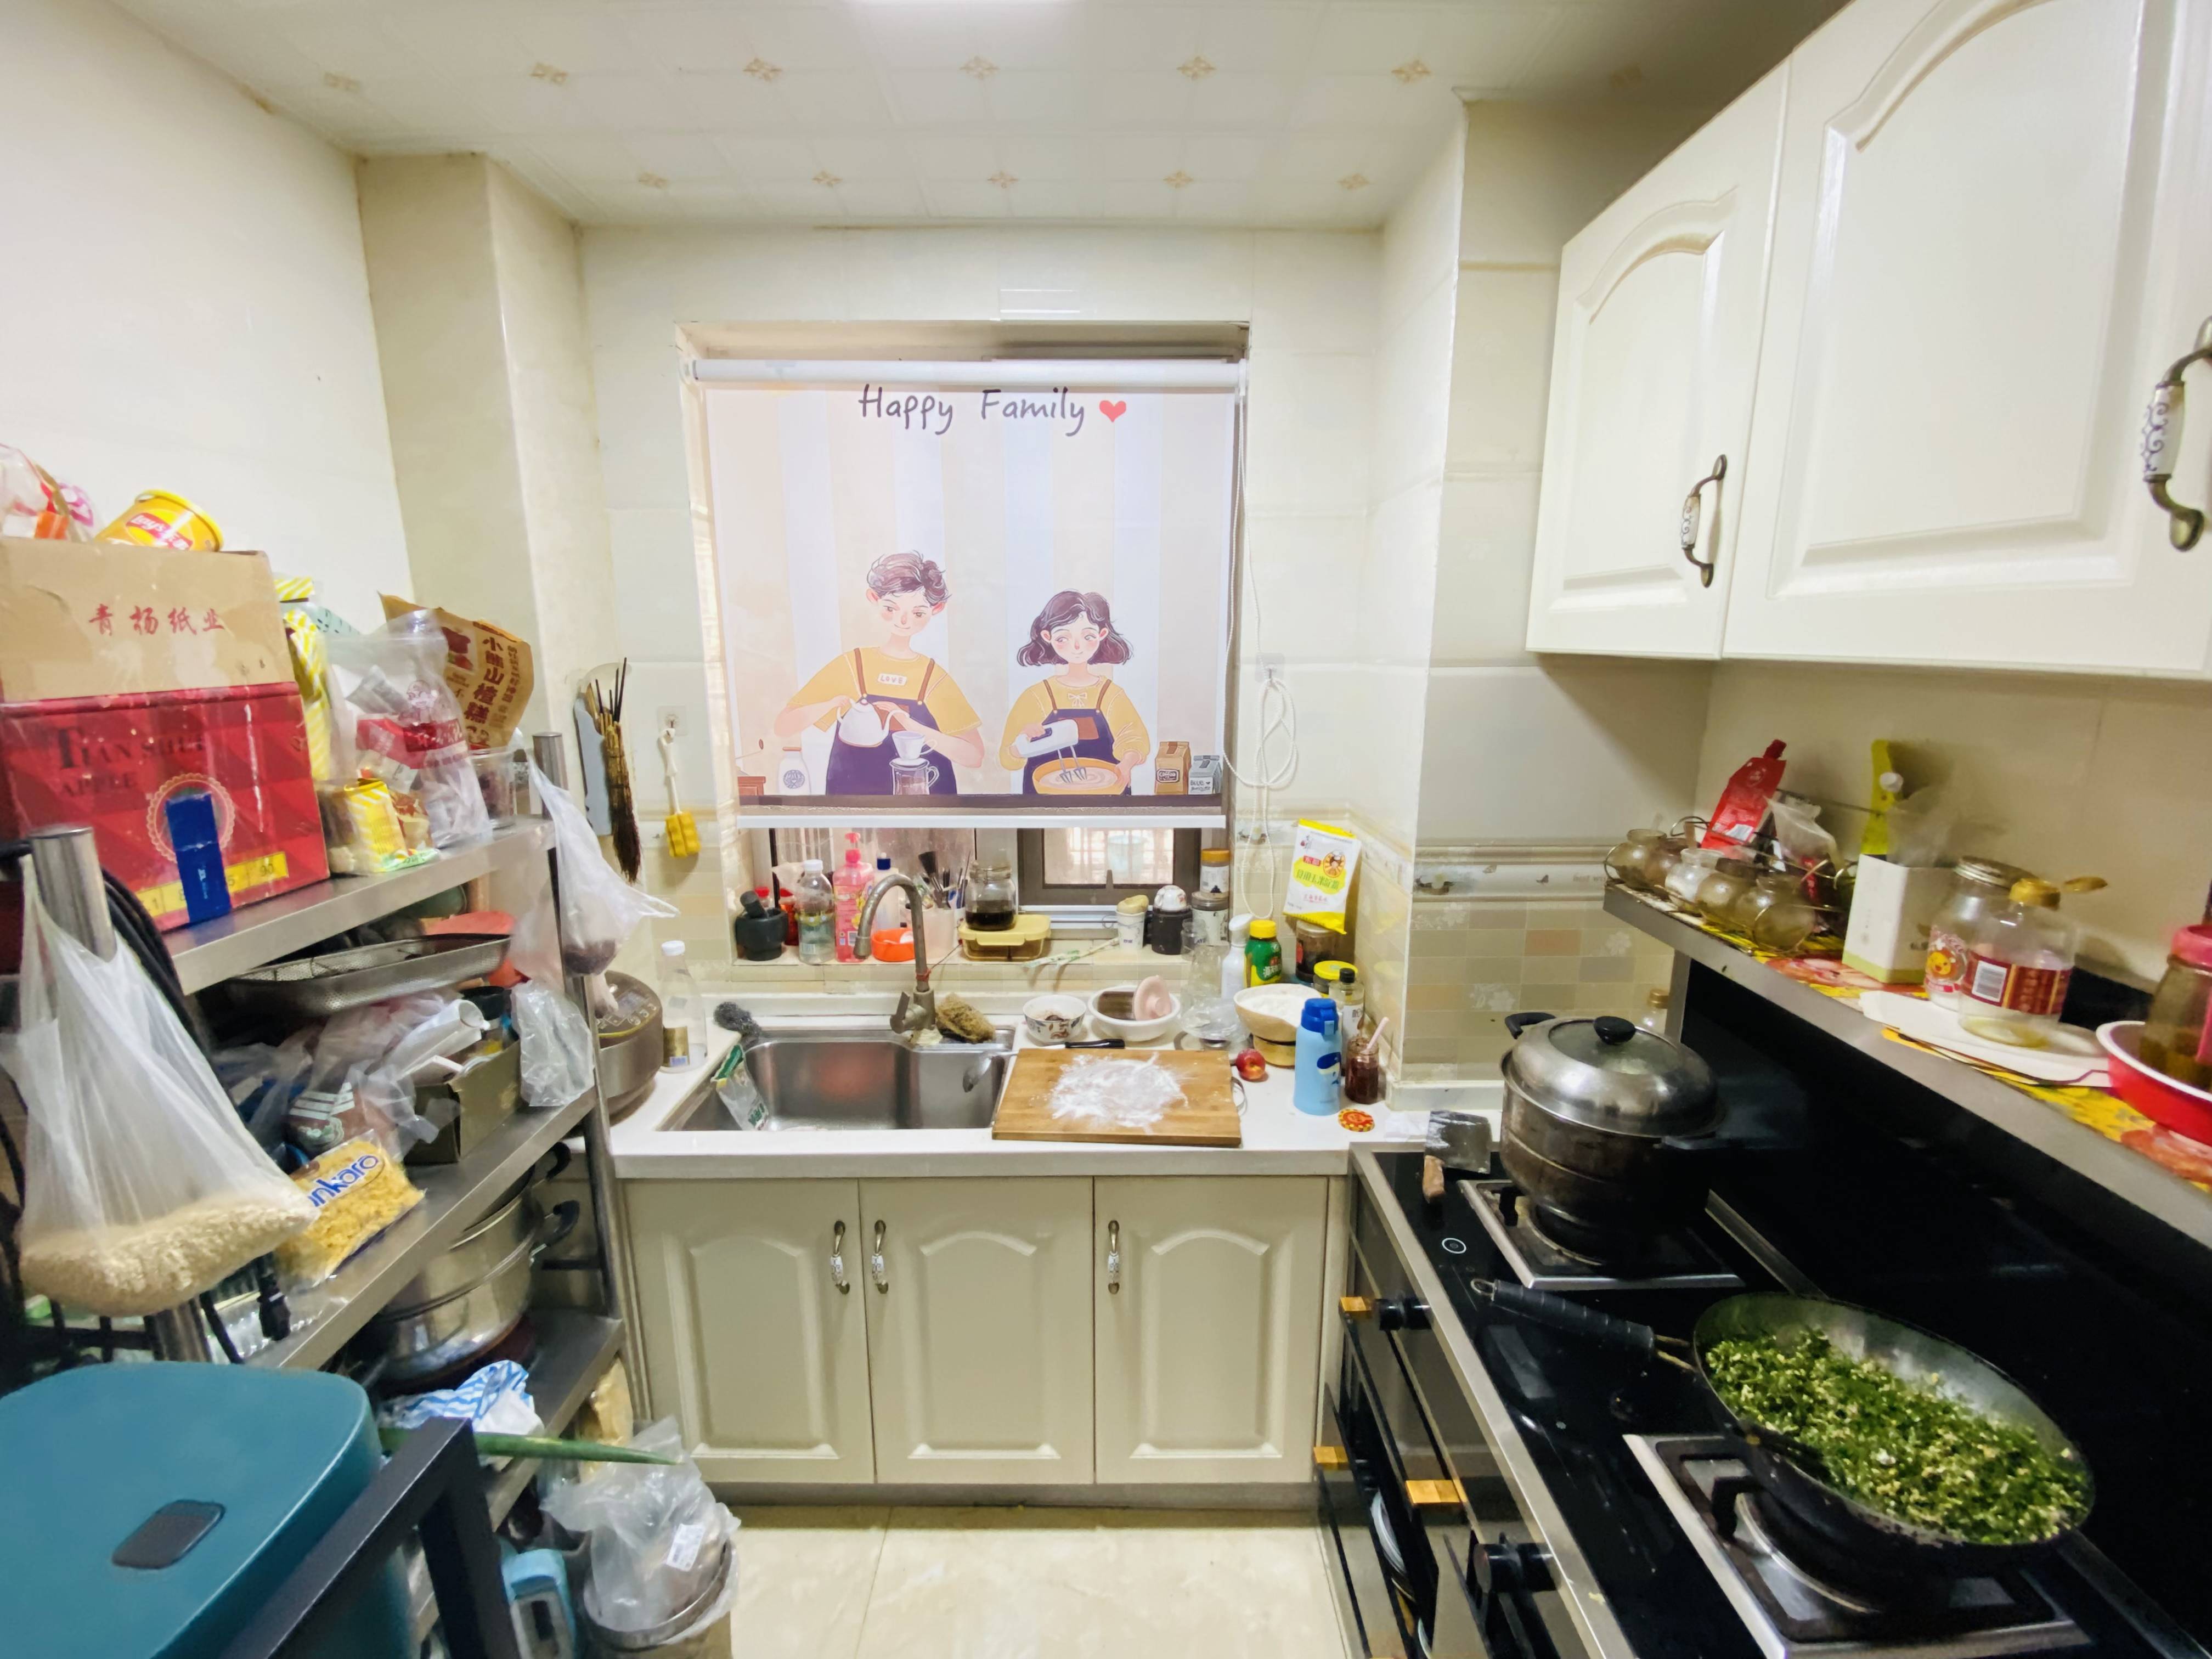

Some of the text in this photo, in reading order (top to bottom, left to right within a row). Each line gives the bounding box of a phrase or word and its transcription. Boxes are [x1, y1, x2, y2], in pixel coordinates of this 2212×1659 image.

[858, 383, 1085, 437] Happy Family
[880, 675, 904, 684] LOVE
